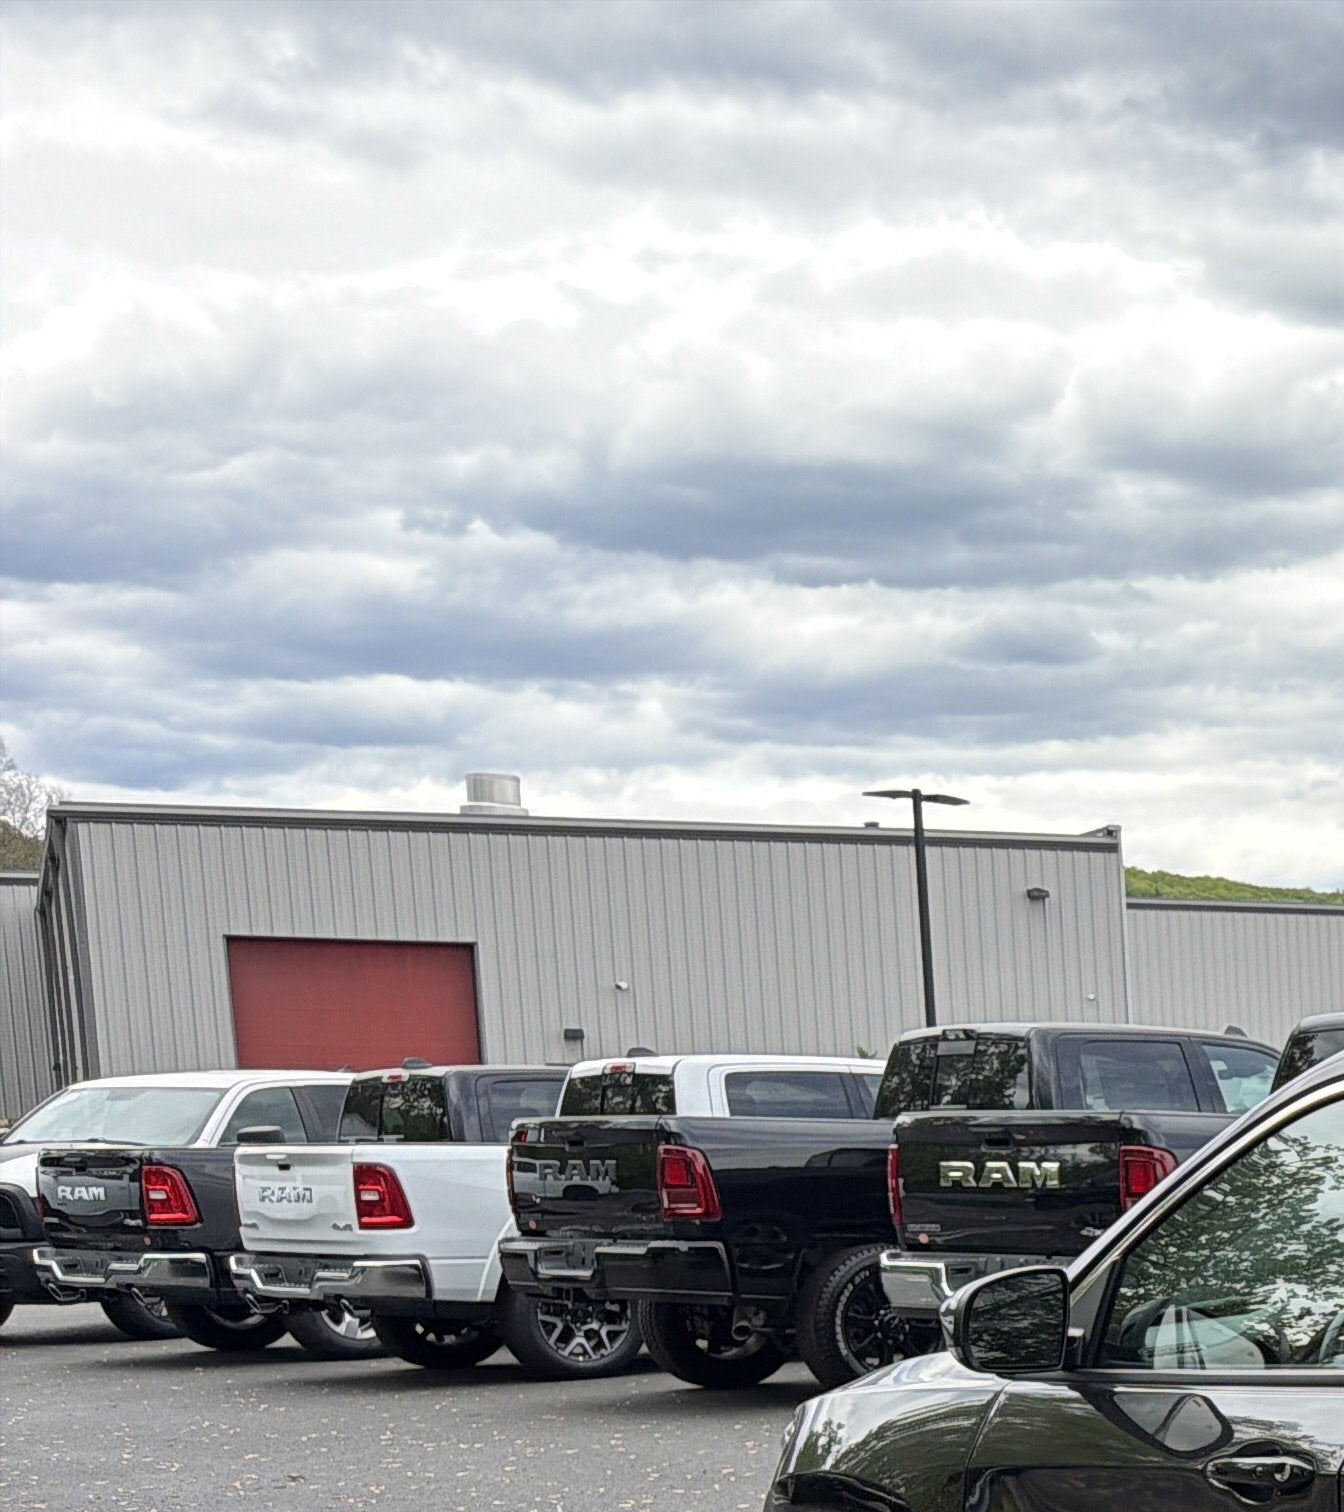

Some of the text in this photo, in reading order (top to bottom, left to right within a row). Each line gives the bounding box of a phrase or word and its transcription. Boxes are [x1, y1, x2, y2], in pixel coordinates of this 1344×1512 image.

[539, 1159, 617, 1181] RAM
[939, 1161, 1061, 1188] RAM
[57, 1185, 106, 1201] RAM
[259, 1186, 313, 1204] RAM
